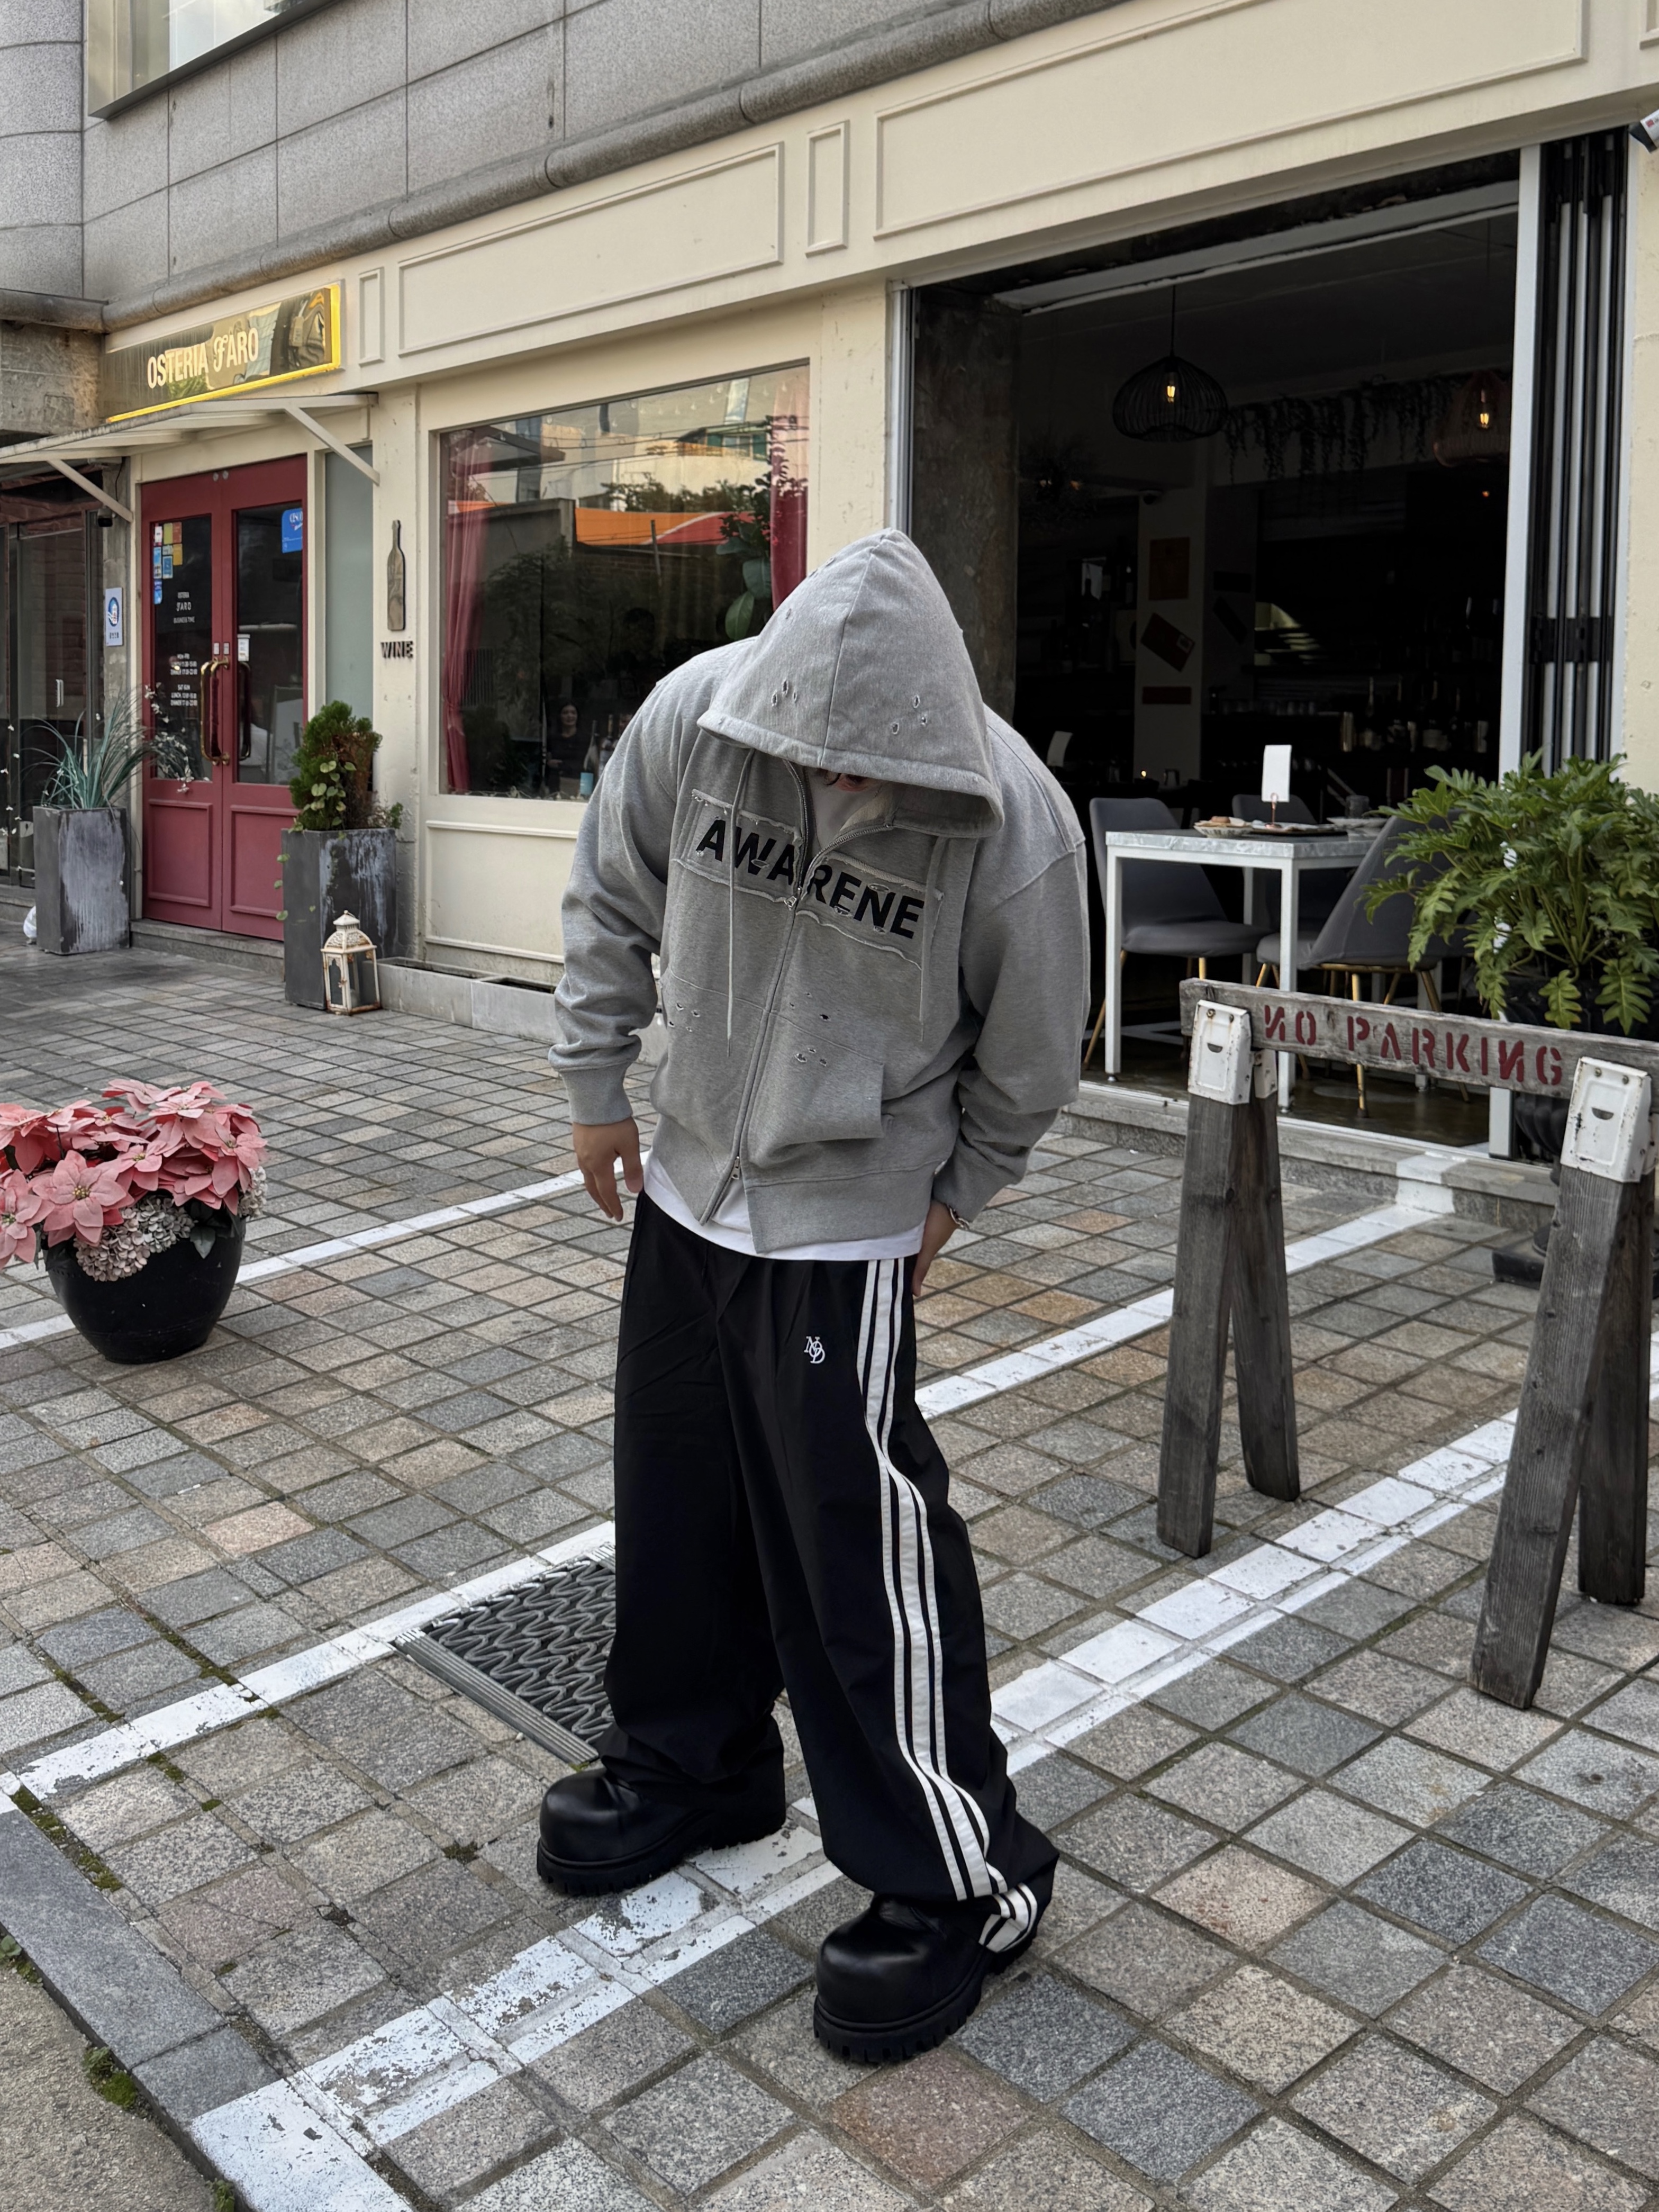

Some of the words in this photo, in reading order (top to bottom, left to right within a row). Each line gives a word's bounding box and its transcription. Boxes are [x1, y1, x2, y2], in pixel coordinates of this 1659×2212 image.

[148, 342, 208, 389] OSTERIA
[213, 328, 259, 372] FARO
[380, 640, 413, 659] WINE
[695, 819, 925, 939] AWARENE
[1264, 1004, 1317, 1046] NO
[1347, 1015, 1562, 1086] PARKING
